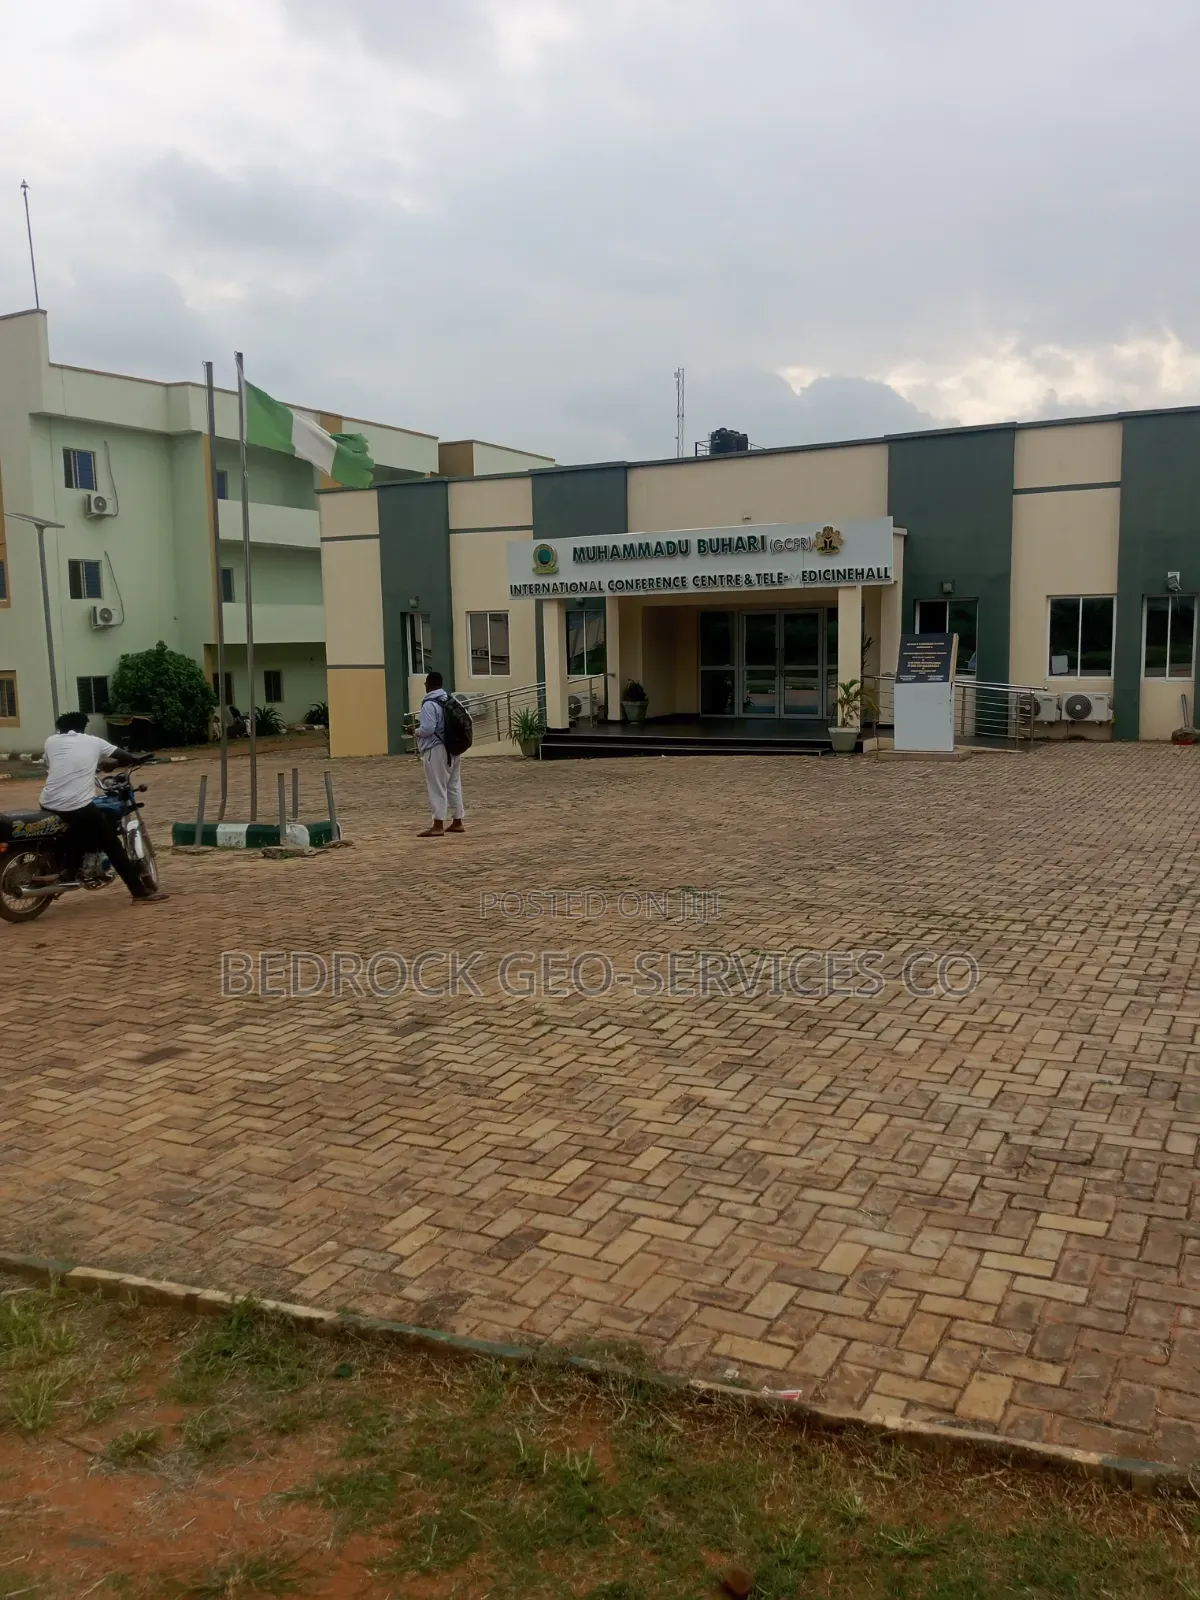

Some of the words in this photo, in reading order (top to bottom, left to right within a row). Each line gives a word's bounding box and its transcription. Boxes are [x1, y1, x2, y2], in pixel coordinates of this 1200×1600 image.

[573, 538, 690, 563] MUHAMMADU
[697, 534, 767, 556] BUHARI
[510, 580, 605, 597] INTERNATIONAL
[607, 575, 688, 592] CONFERENCE
